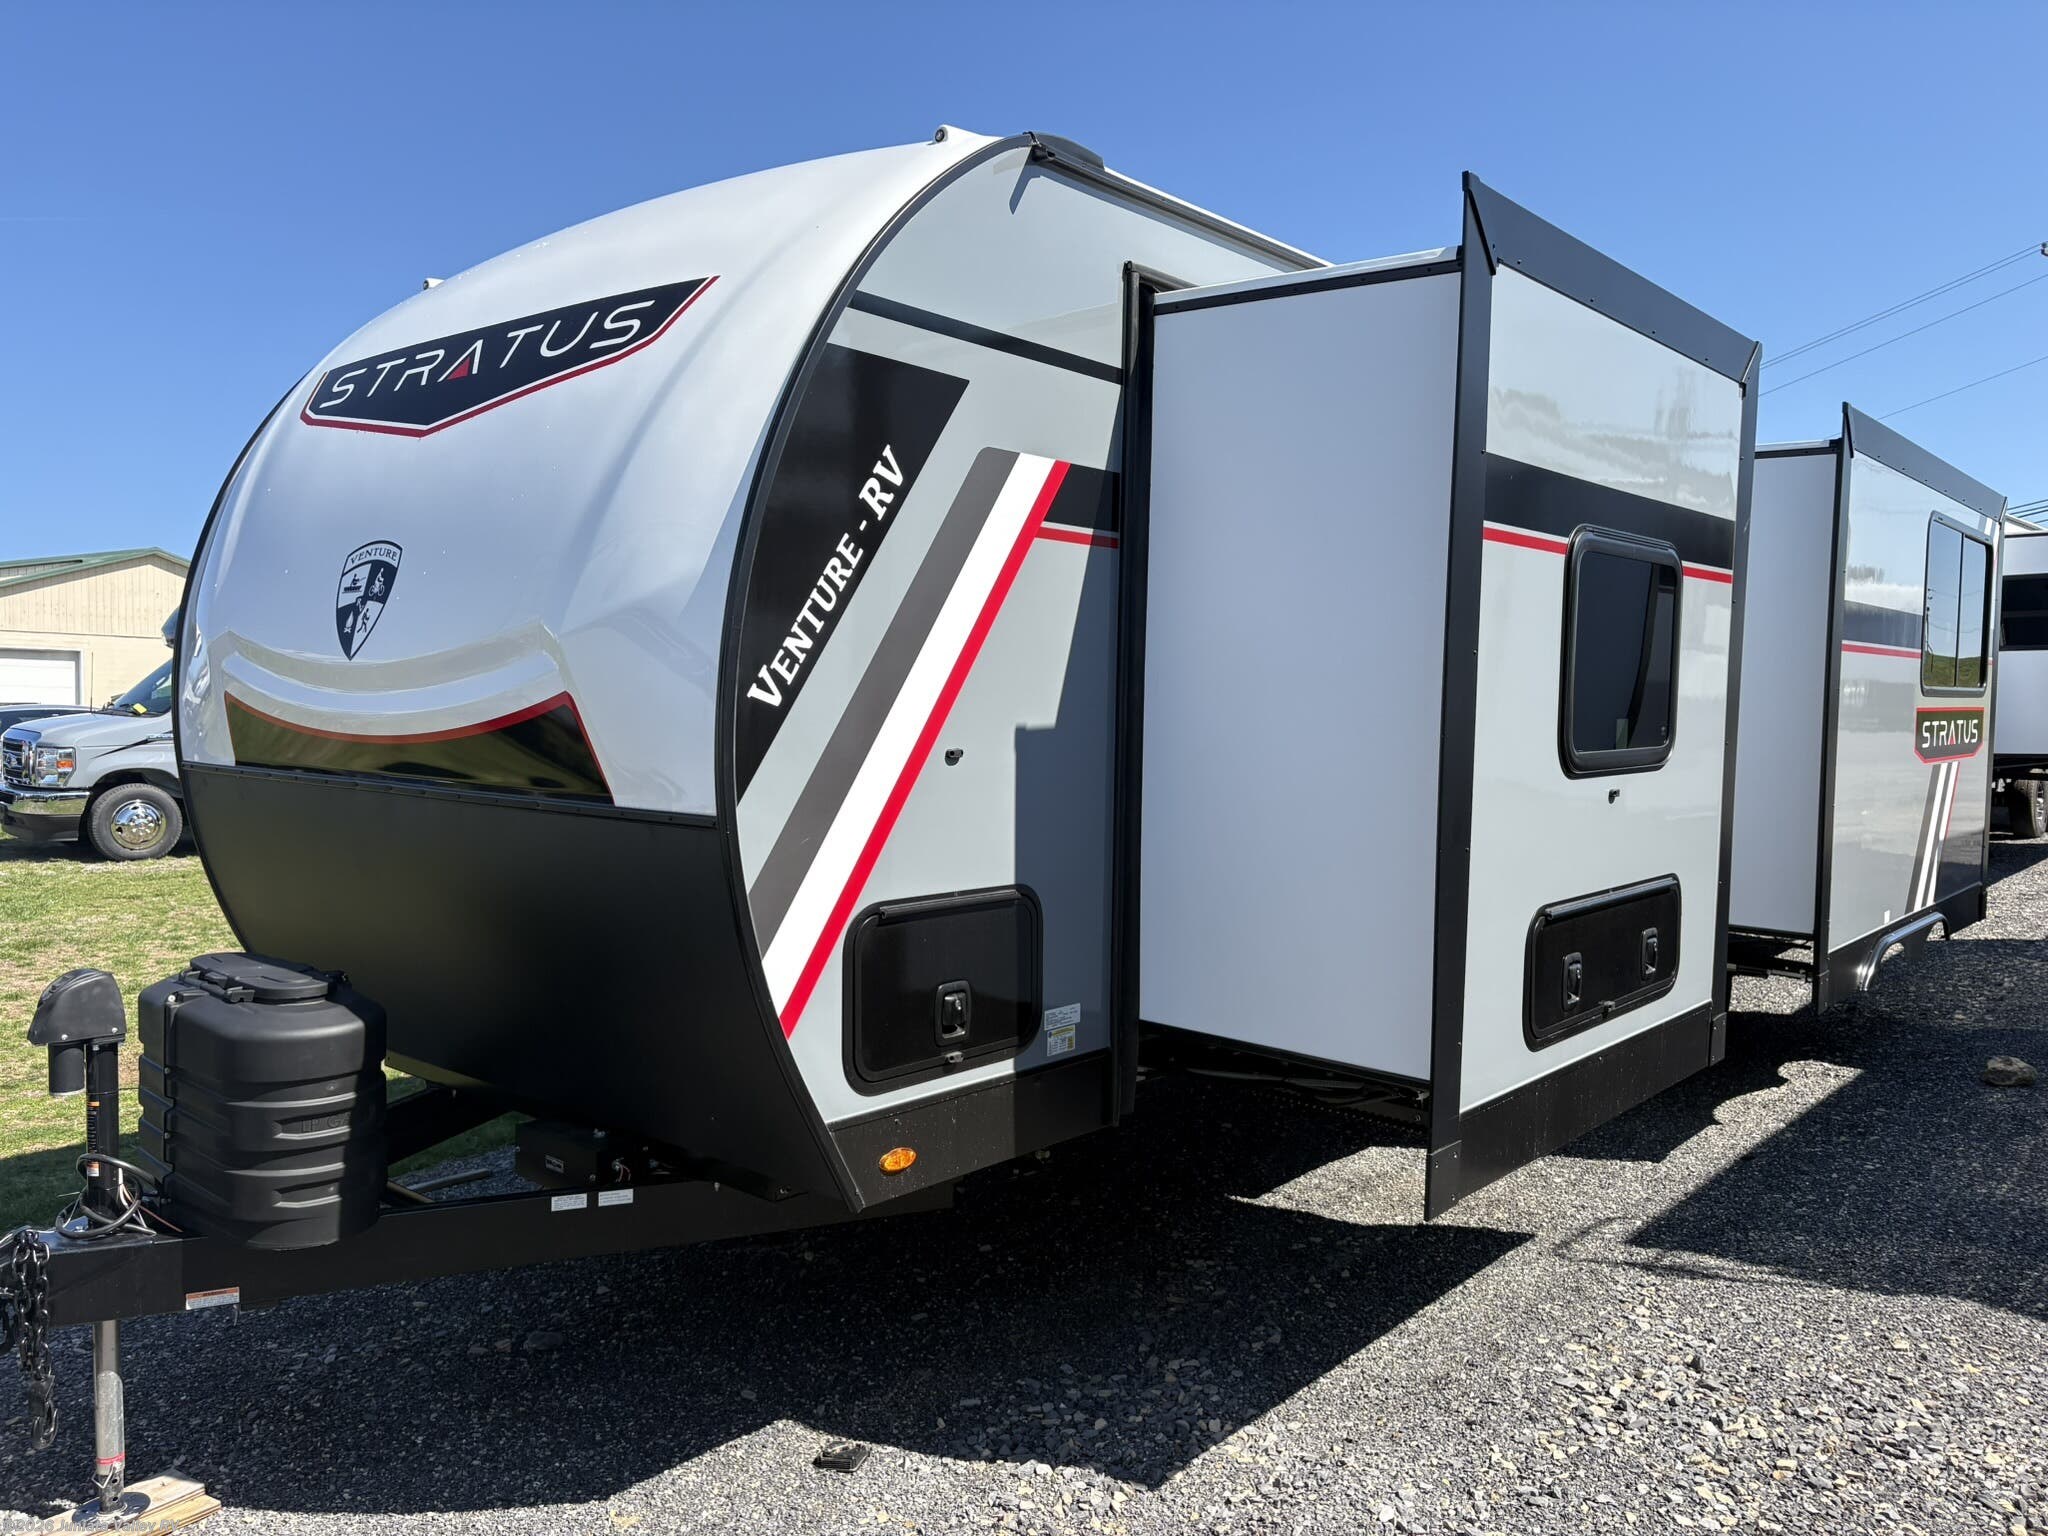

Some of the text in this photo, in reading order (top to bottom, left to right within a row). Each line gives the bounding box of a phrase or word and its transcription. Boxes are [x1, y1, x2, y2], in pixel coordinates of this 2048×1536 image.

[320, 300, 655, 409] STRATUS
[351, 547, 398, 565] VENTURE
[747, 532, 864, 707] VENTURE
[858, 444, 904, 521] RV
[1922, 719, 1979, 748] STRATUS
